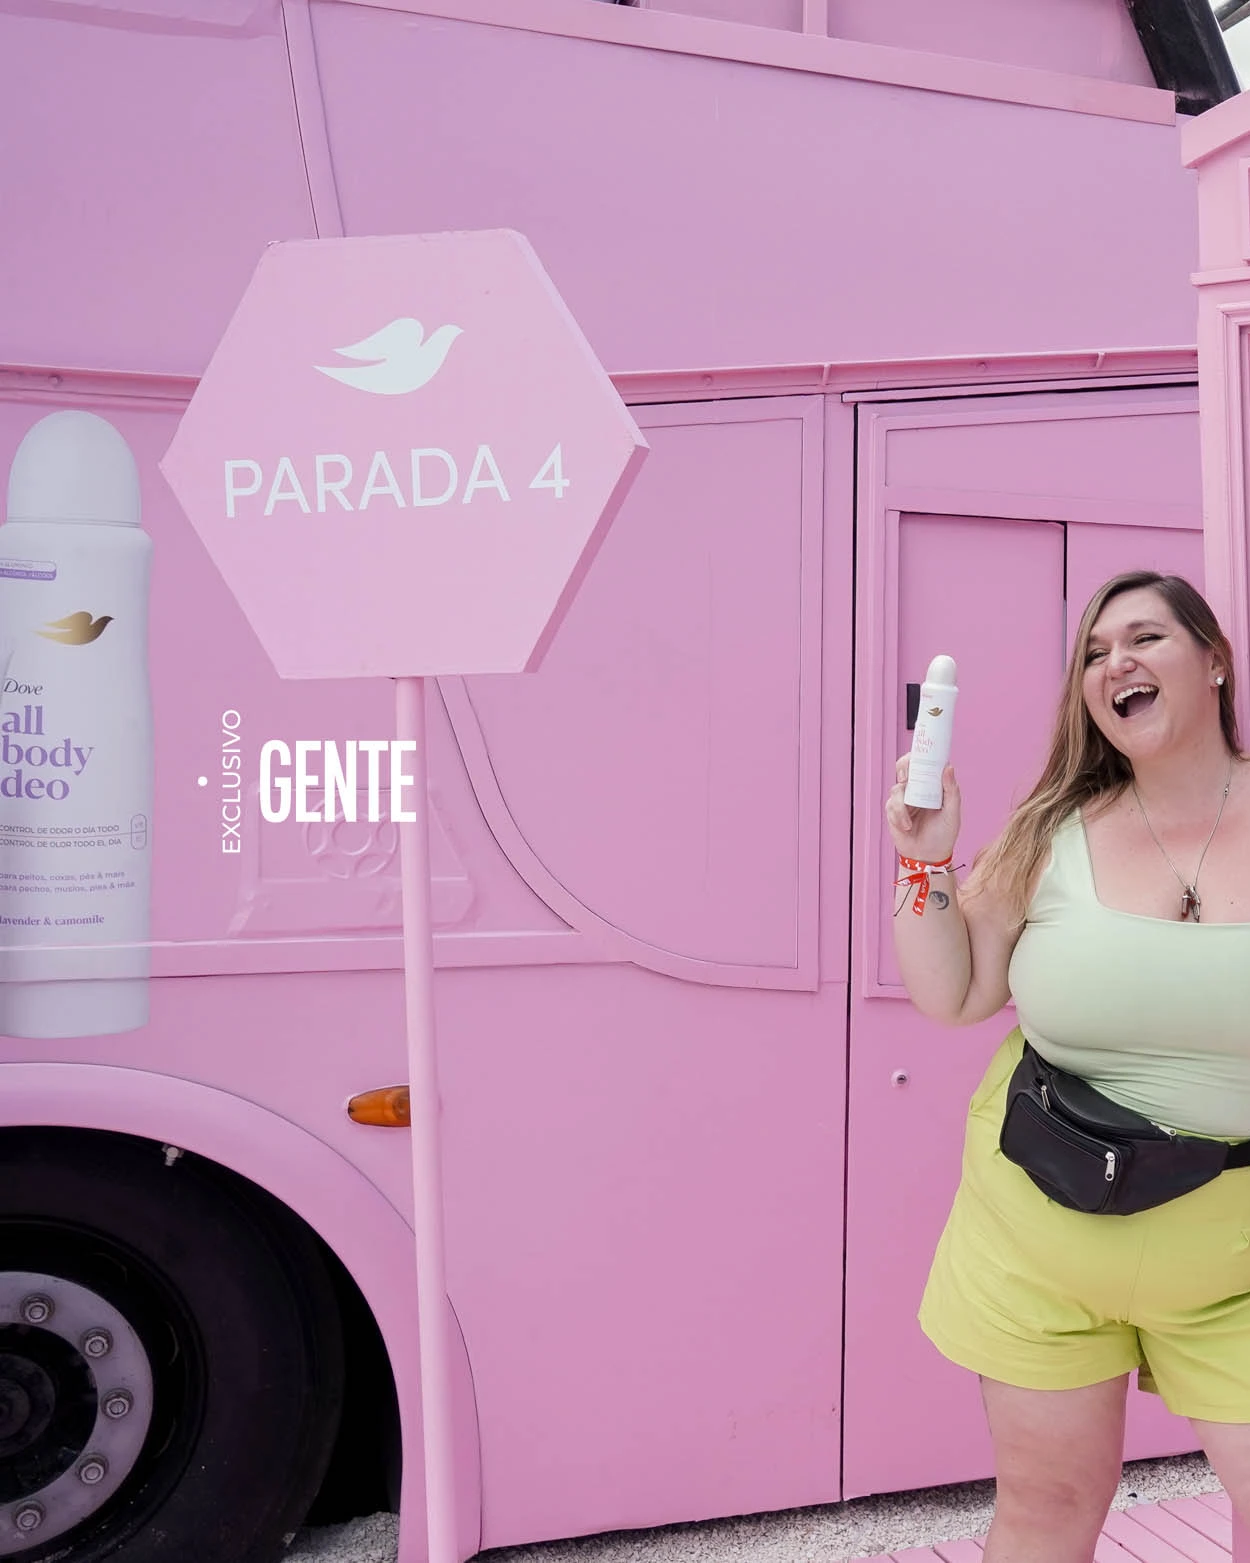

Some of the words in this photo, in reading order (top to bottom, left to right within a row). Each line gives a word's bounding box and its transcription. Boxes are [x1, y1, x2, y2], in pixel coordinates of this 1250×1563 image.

[224, 443, 512, 519] PARADA
[528, 442, 571, 499] 4
[3, 678, 43, 695] Dove
[1, 704, 45, 735] all
[1, 734, 95, 776] body
[0, 769, 70, 801] deo
[0, 915, 41, 926] lavender
[43, 916, 52, 926] &
[55, 914, 105, 926] camomile
